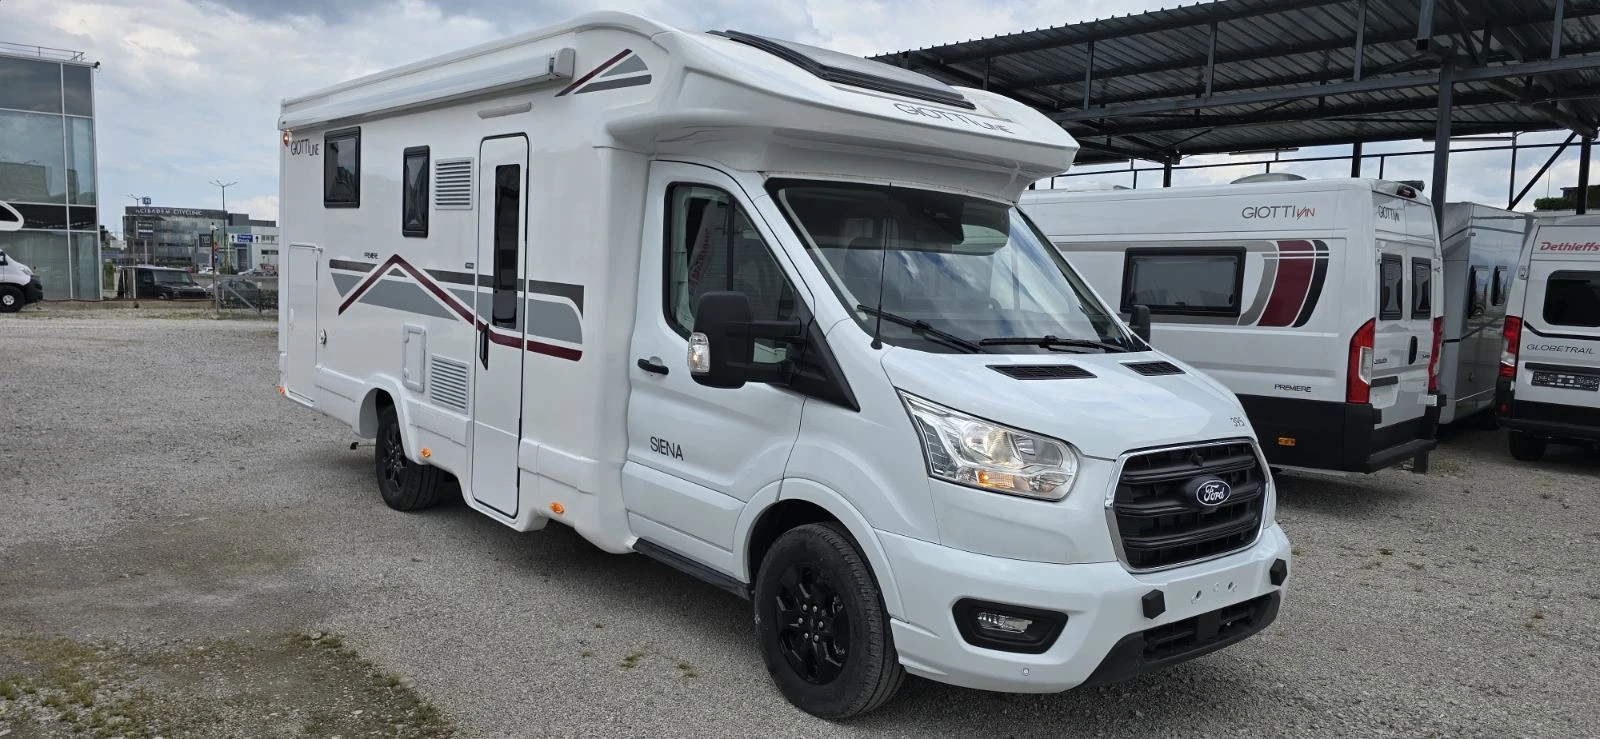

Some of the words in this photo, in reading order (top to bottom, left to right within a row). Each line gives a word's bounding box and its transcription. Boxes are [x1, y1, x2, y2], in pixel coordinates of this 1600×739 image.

[1539, 241, 1600, 253] Dethleffs
[1526, 343, 1596, 355] GLOBETRAIL
[1274, 383, 1312, 393] PREMIERE
[650, 436, 684, 461] SIENA
[1203, 484, 1225, 502] Ford
